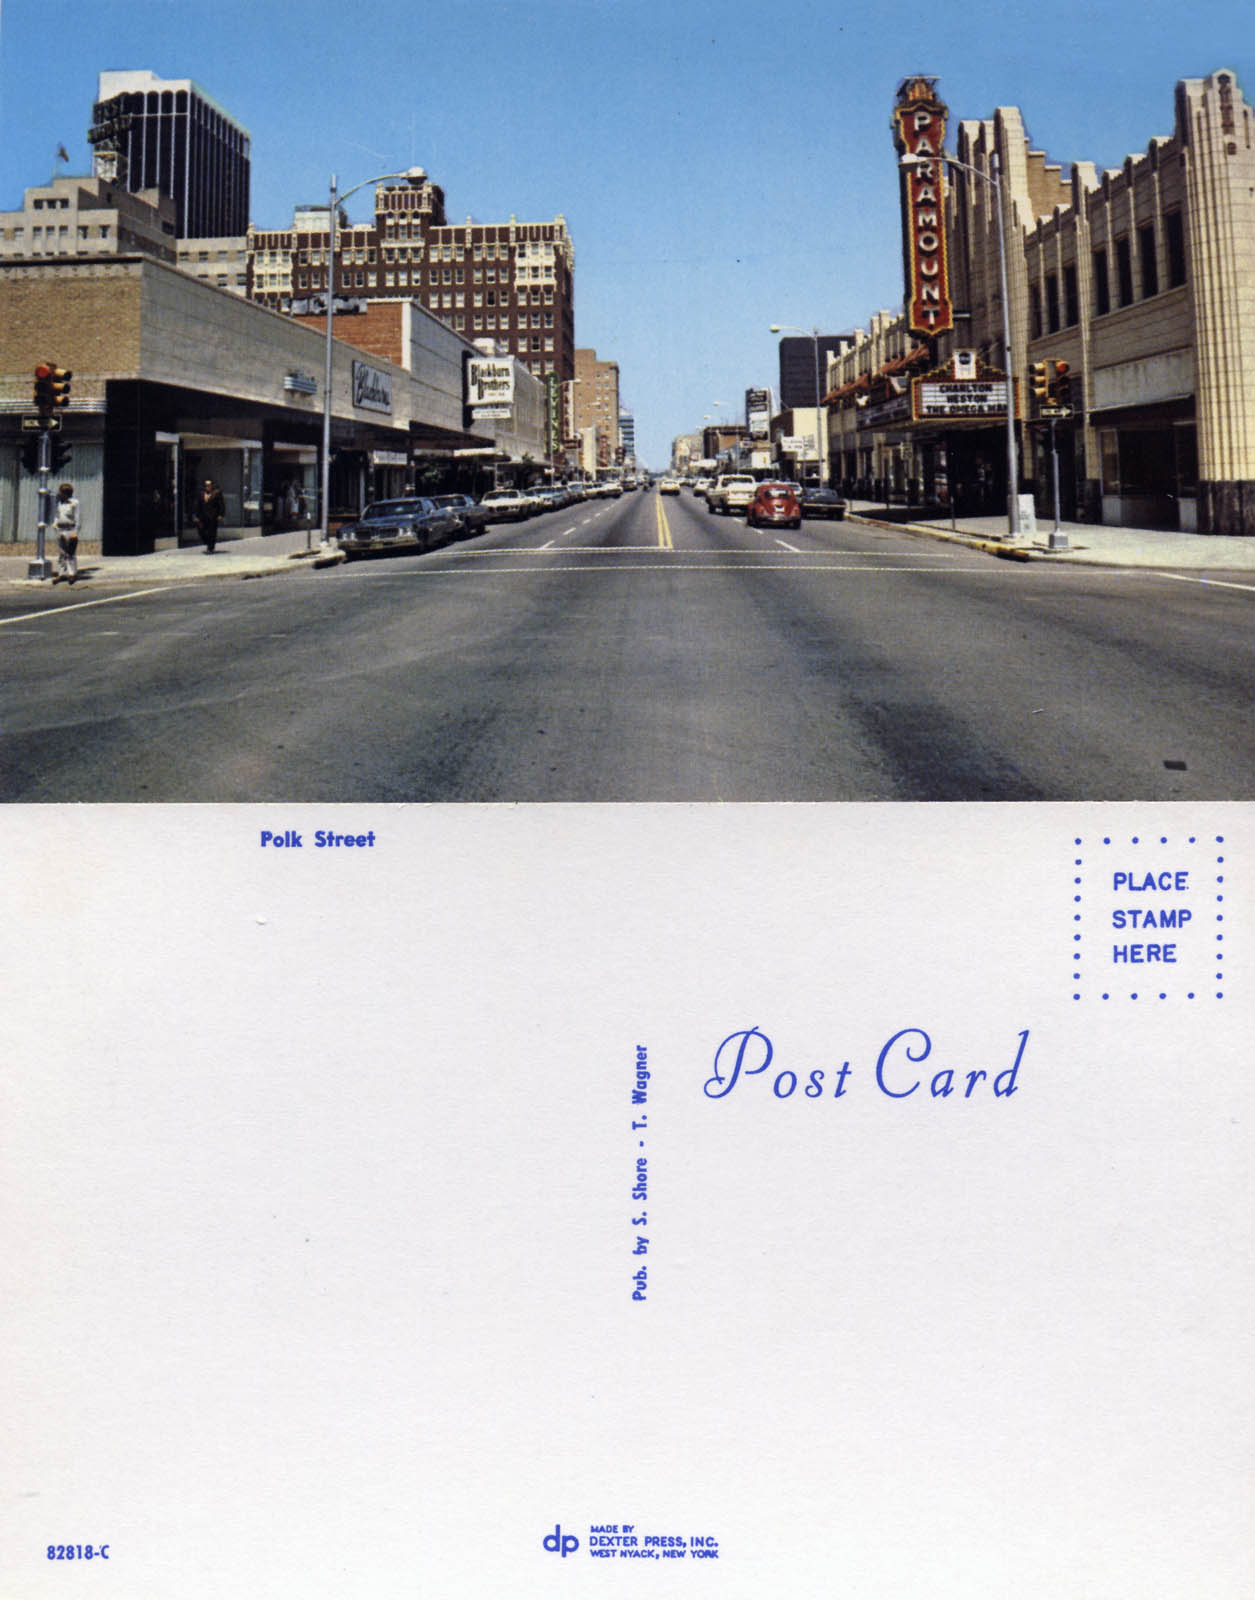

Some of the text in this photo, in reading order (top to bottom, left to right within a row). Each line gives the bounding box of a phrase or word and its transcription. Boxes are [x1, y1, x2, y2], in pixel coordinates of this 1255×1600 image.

[914, 112, 940, 326] PARAMOUNT
[939, 383, 993, 393] CHARLTON
[926, 404, 945, 414] THE
[949, 404, 985, 414] OMEGA
[261, 830, 376, 848] Polk Street
[1113, 872, 1189, 891] PLACE
[1112, 909, 1192, 929] STAMP
[1113, 944, 1177, 963] HERE
[704, 1026, 1030, 1099] Post Card
[632, 1045, 651, 1104] Wagner
[632, 1115, 648, 1130] T.
[632, 1158, 648, 1200] Shore
[632, 1211, 648, 1225] S.
[632, 1235, 650, 1255] by
[632, 1265, 648, 1301] Pub.
[590, 1525, 635, 1534] MADE BY
[543, 1524, 580, 1558] dp
[589, 1536, 719, 1548] DEXTER PRESS, INC.
[47, 1544, 110, 1560] 82818-C
[590, 1549, 719, 1560] WEST NYACK, NEW YORK
